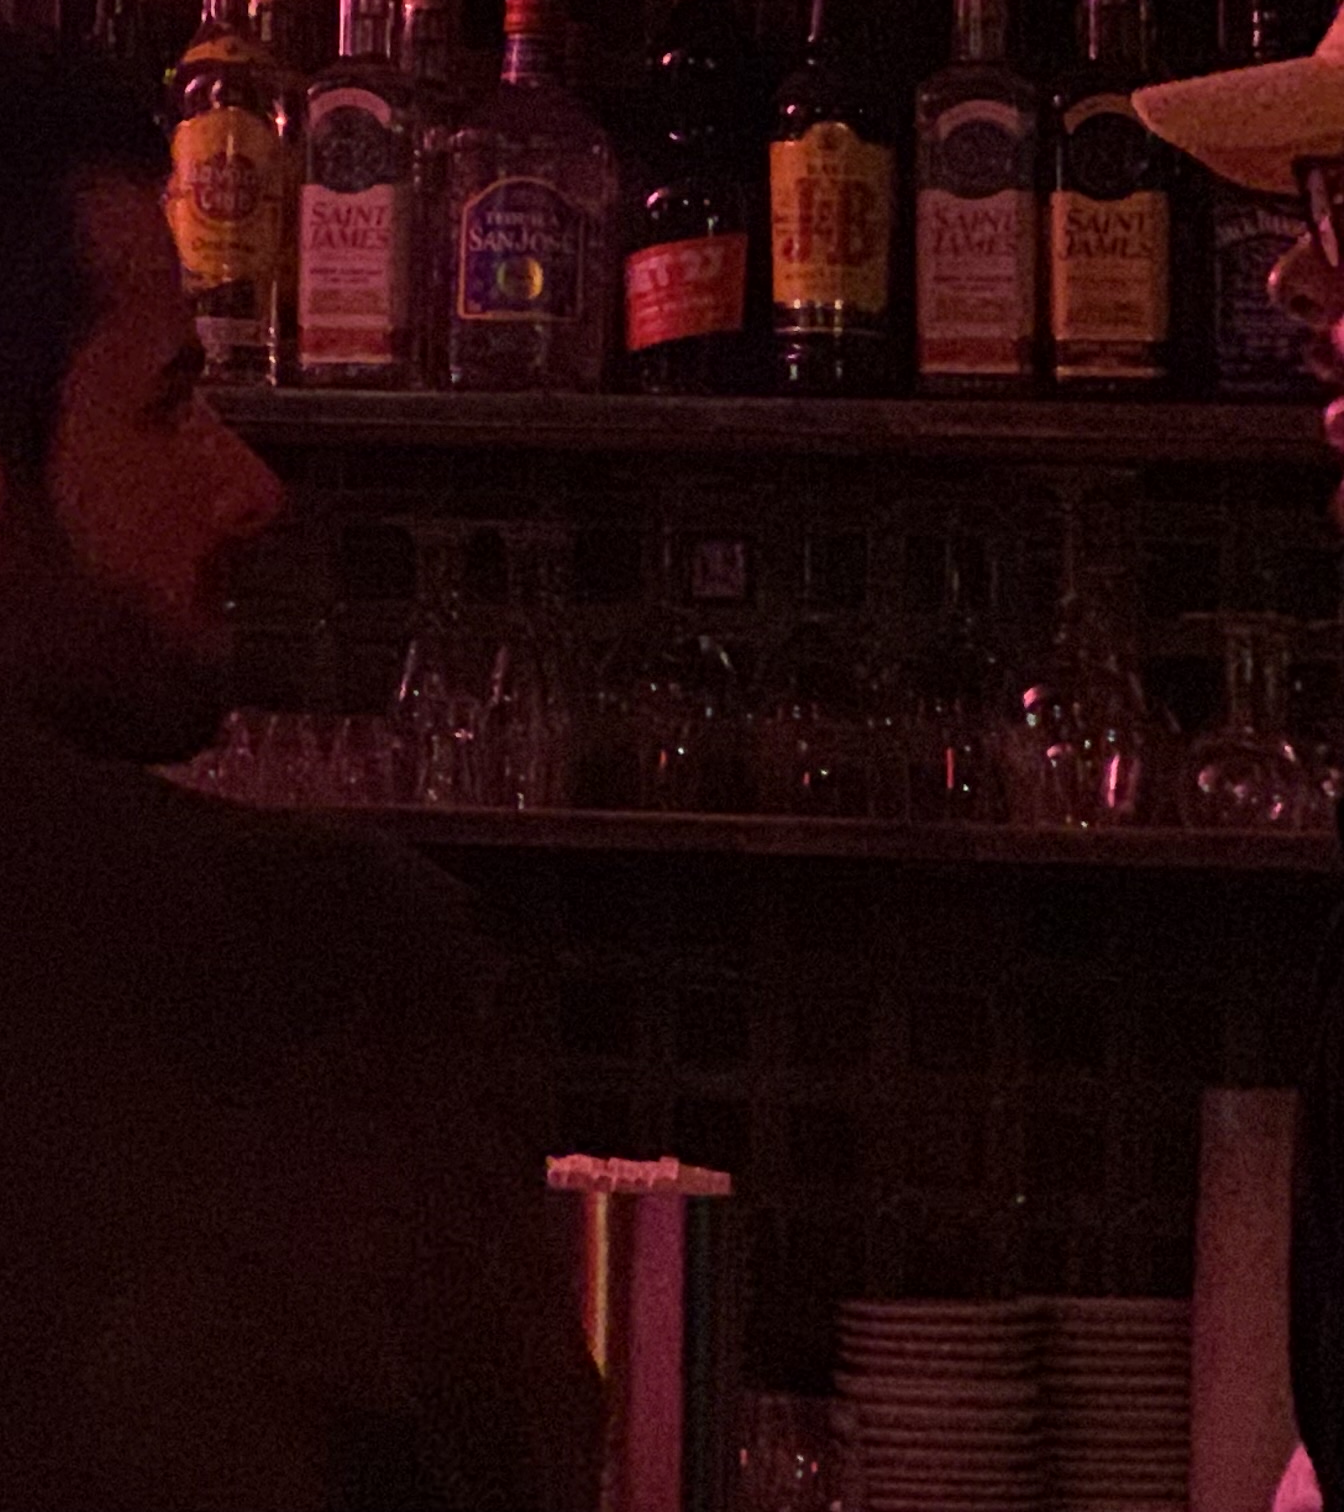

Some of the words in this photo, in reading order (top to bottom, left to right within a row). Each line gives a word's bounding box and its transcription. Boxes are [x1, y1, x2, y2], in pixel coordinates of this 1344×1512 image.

[310, 203, 386, 227] SAINT
[933, 210, 1012, 235] SAINT
[1066, 210, 1148, 235] SAINT
[307, 226, 389, 248] JAMES
[1060, 234, 1151, 260] JAMES
